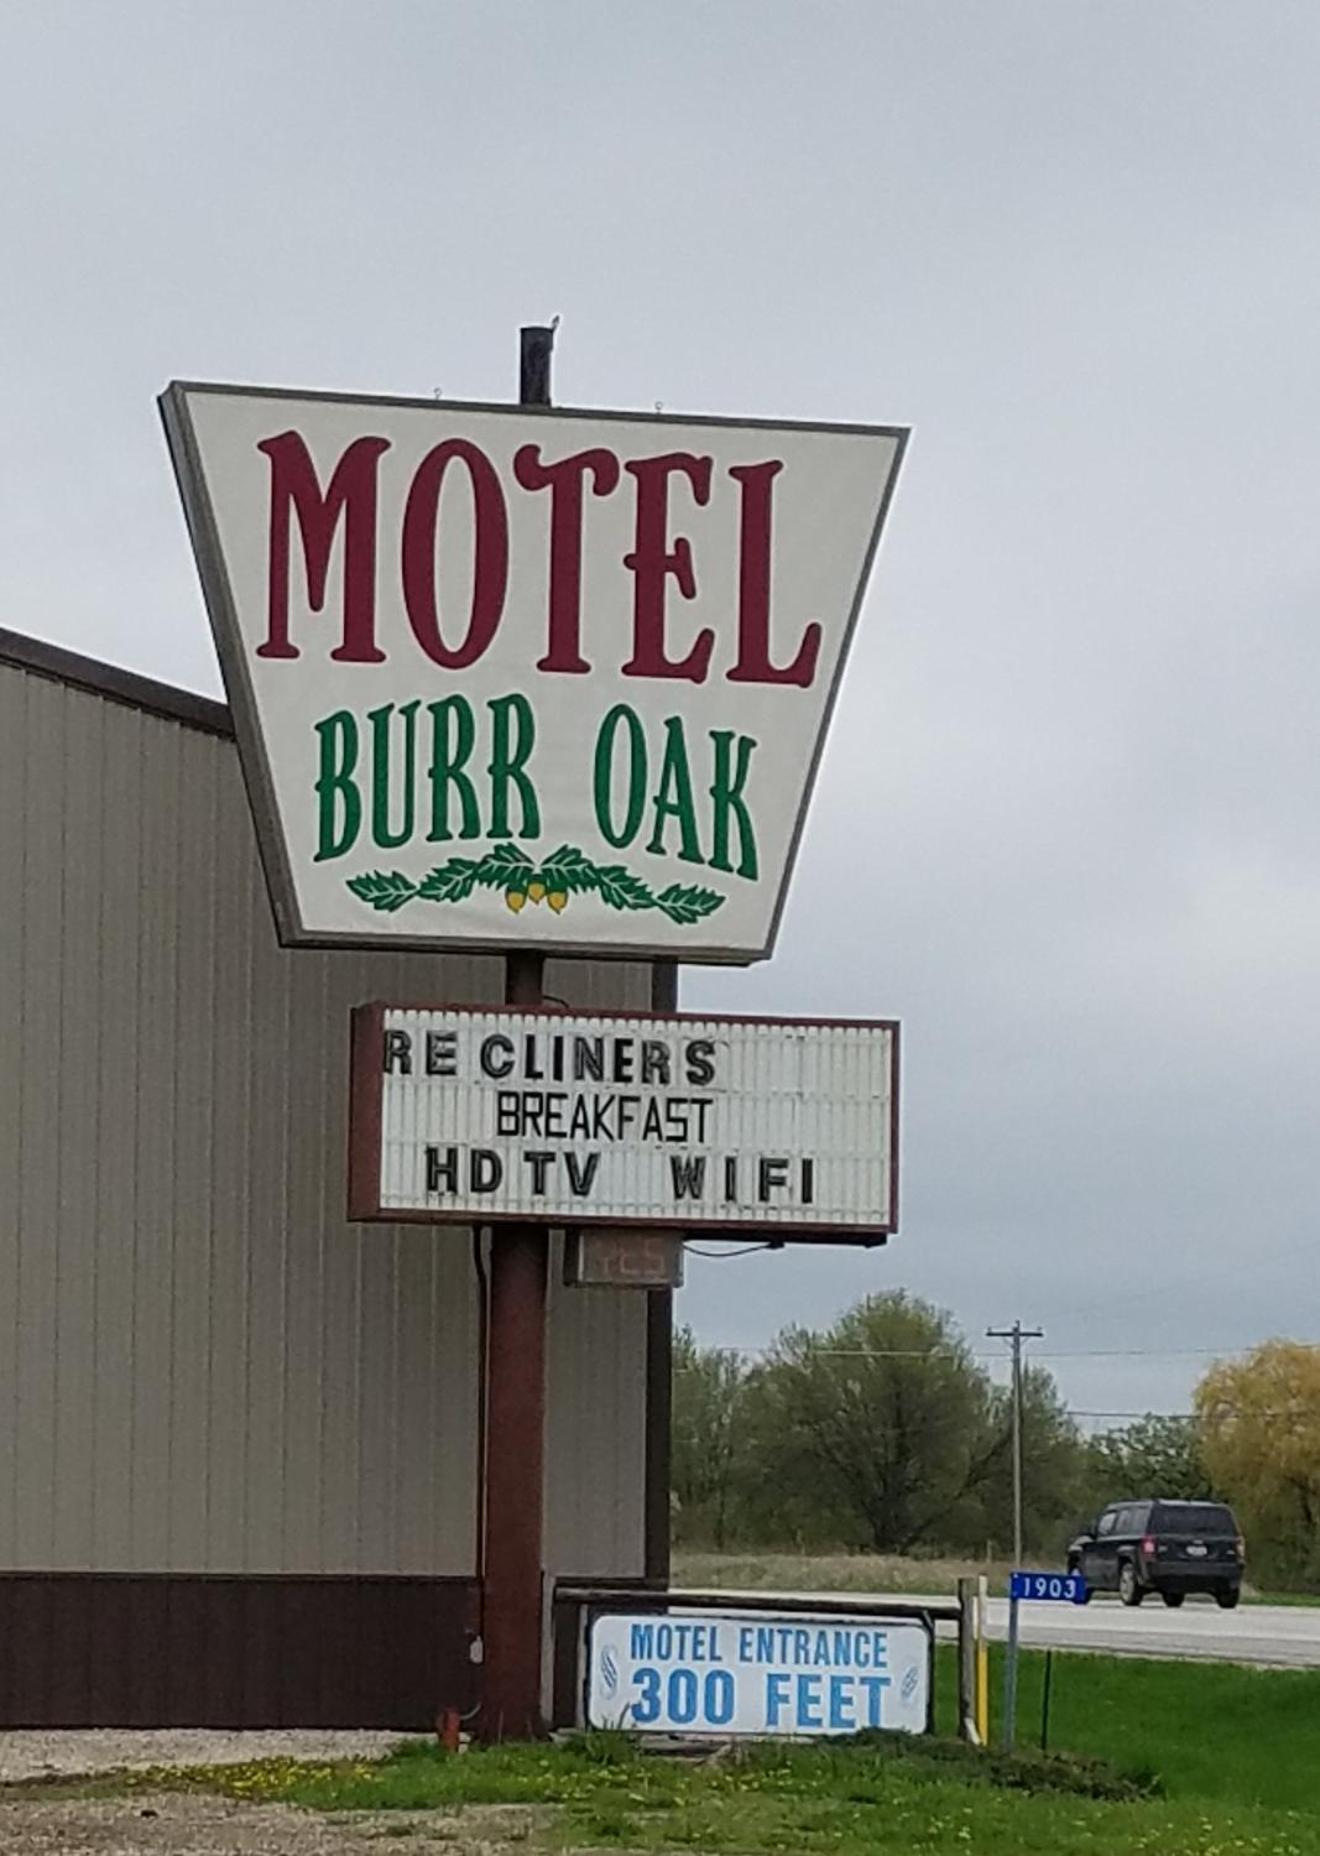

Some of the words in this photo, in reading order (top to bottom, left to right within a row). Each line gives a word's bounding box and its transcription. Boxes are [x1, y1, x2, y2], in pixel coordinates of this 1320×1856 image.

[257, 430, 821, 688] MOTEL
[314, 693, 541, 863] BURR
[593, 703, 758, 881] OAK
[496, 1089, 714, 1144] BREAKFAST
[670, 1155, 815, 1204] WIFI
[1023, 1576, 1077, 1598] 1903
[629, 1622, 722, 1664] MOTEL
[738, 1626, 888, 1669] ENTRANCE
[629, 1666, 736, 1726] 300
[764, 1671, 892, 1731] FEET
